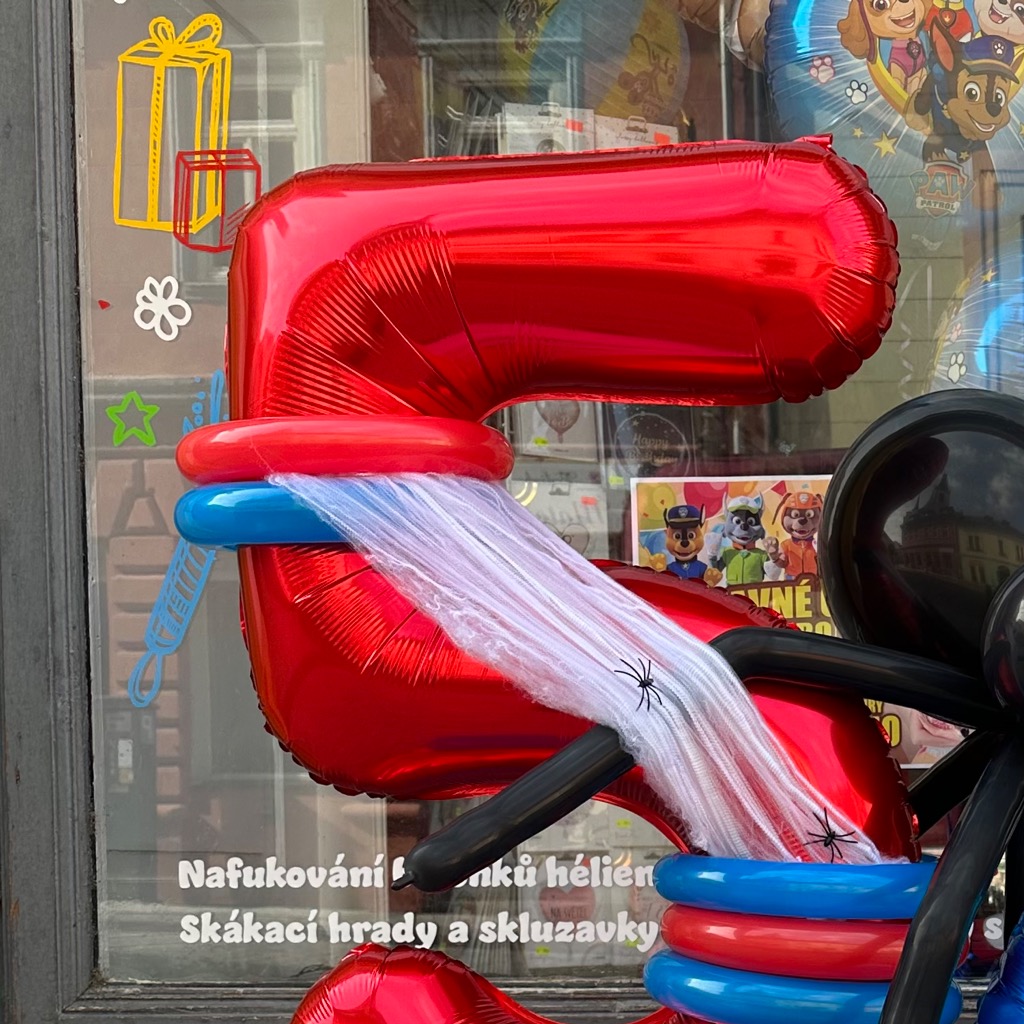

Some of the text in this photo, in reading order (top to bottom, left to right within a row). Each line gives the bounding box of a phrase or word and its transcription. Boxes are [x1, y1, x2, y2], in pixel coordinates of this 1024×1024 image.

[909, 170, 976, 201] PAW
[920, 200, 956, 211] PATROL
[632, 433, 669, 450] Happy
[178, 853, 384, 889] Nafukování
[179, 909, 318, 944] Skákací
[328, 911, 438, 950] hrady
[447, 920, 470, 944] a
[478, 911, 659, 953] skluzavky
